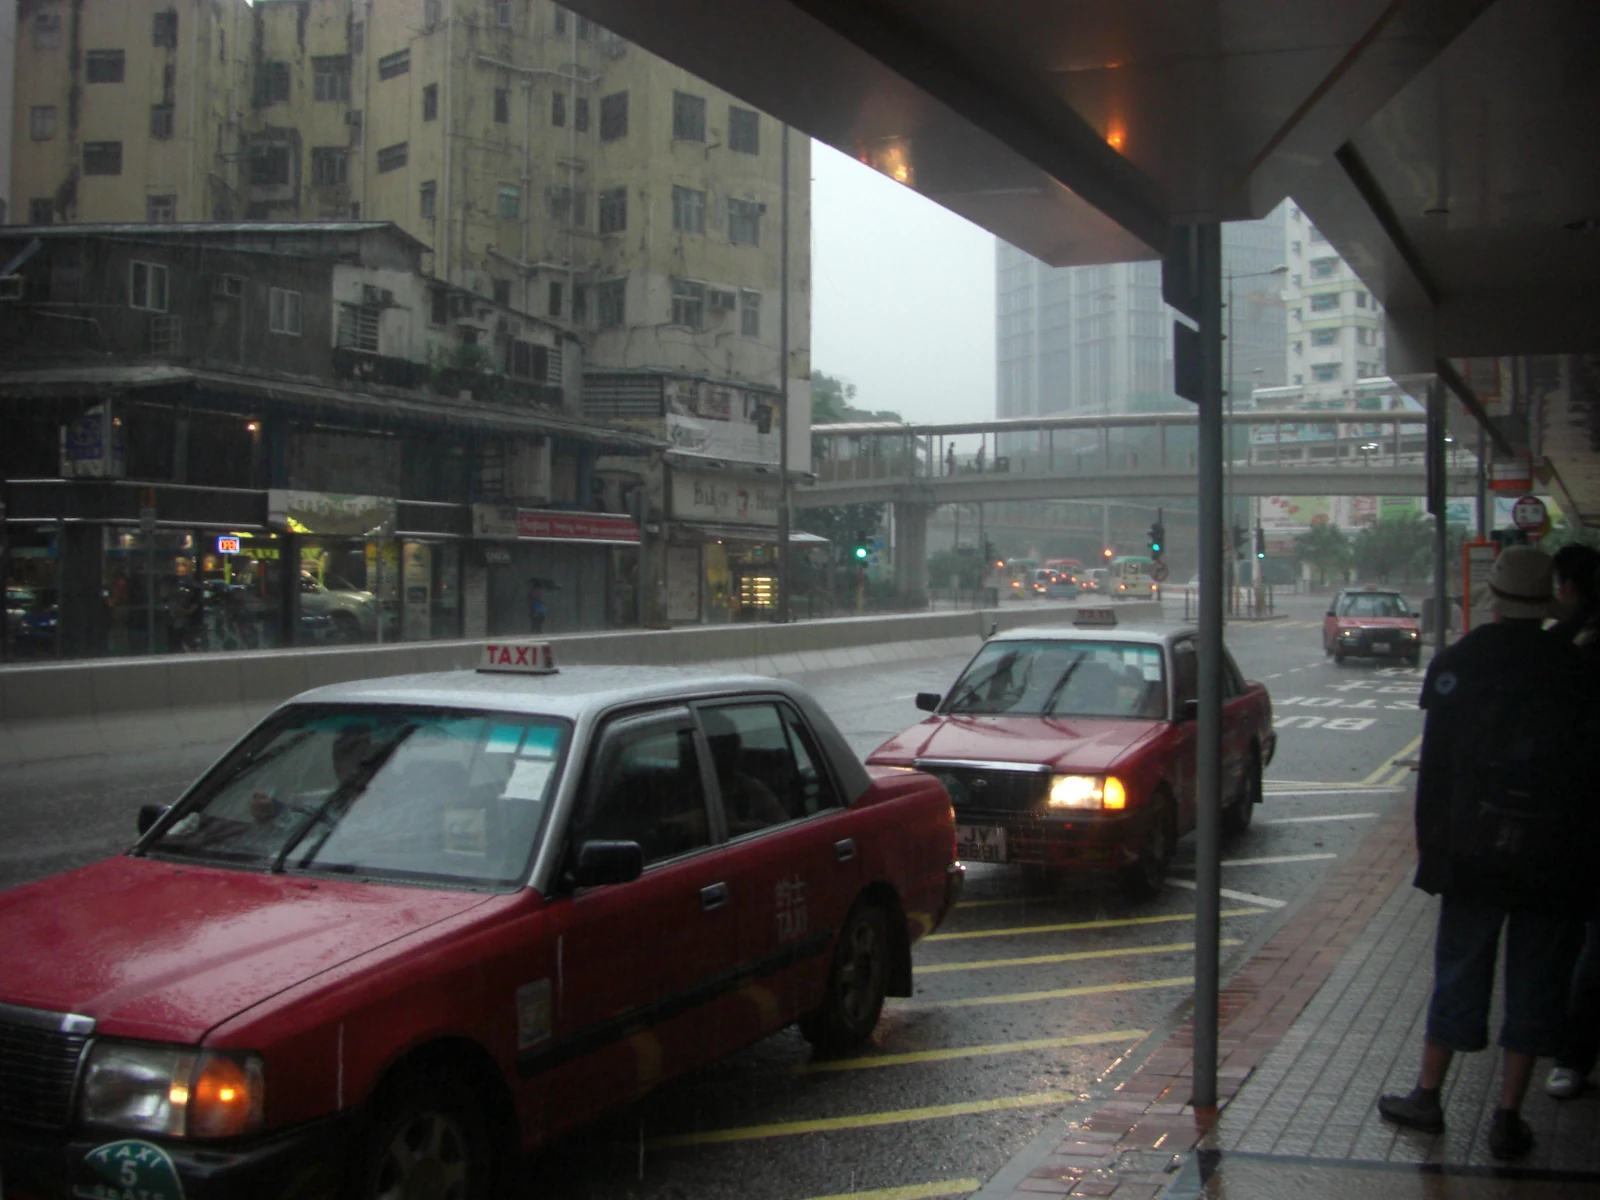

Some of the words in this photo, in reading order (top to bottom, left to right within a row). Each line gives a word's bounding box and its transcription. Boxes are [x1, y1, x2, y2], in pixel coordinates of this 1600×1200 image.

[485, 644, 538, 666] TAXI
[1272, 715, 1377, 731] BU
[96, 1145, 162, 1169] TAXI
[120, 1160, 138, 1187] 5
